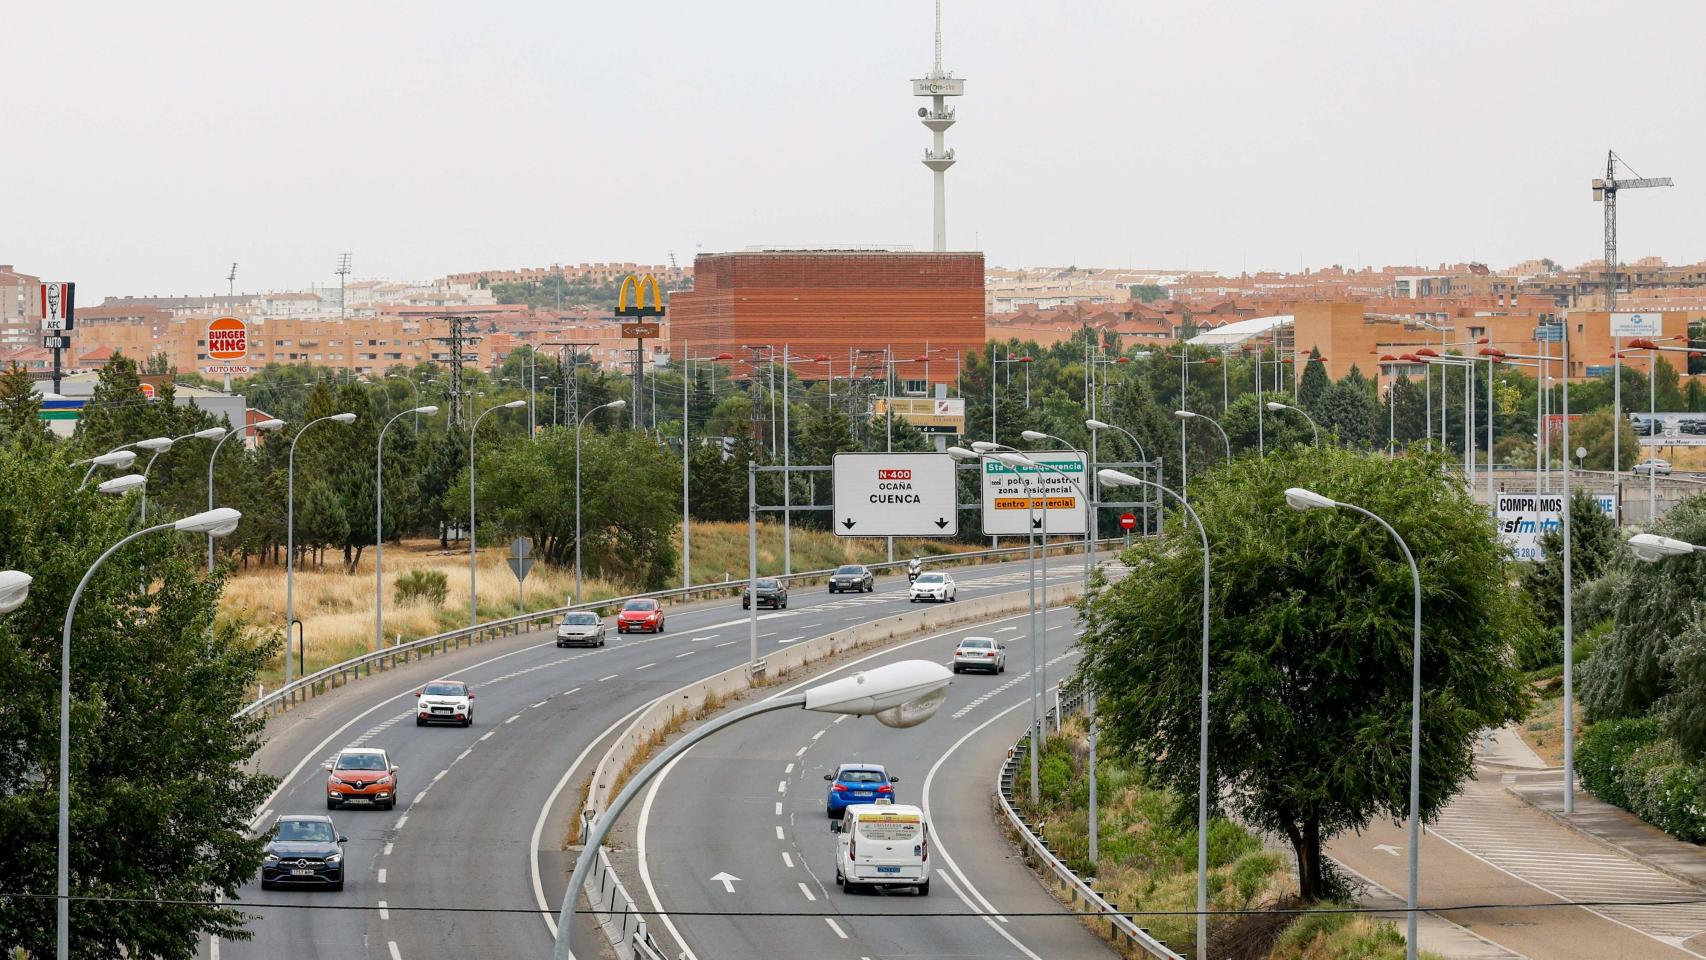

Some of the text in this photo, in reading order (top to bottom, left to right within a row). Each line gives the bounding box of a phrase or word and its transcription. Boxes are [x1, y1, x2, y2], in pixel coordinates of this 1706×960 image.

[47, 320, 61, 329] KFC
[209, 331, 246, 340] BURGER
[46, 337, 62, 348] AUTO
[209, 339, 246, 352] KING
[880, 471, 911, 479] N-400
[879, 482, 912, 490] OCAÑA
[870, 494, 921, 504] CUENCA
[996, 500, 1025, 508] centro
